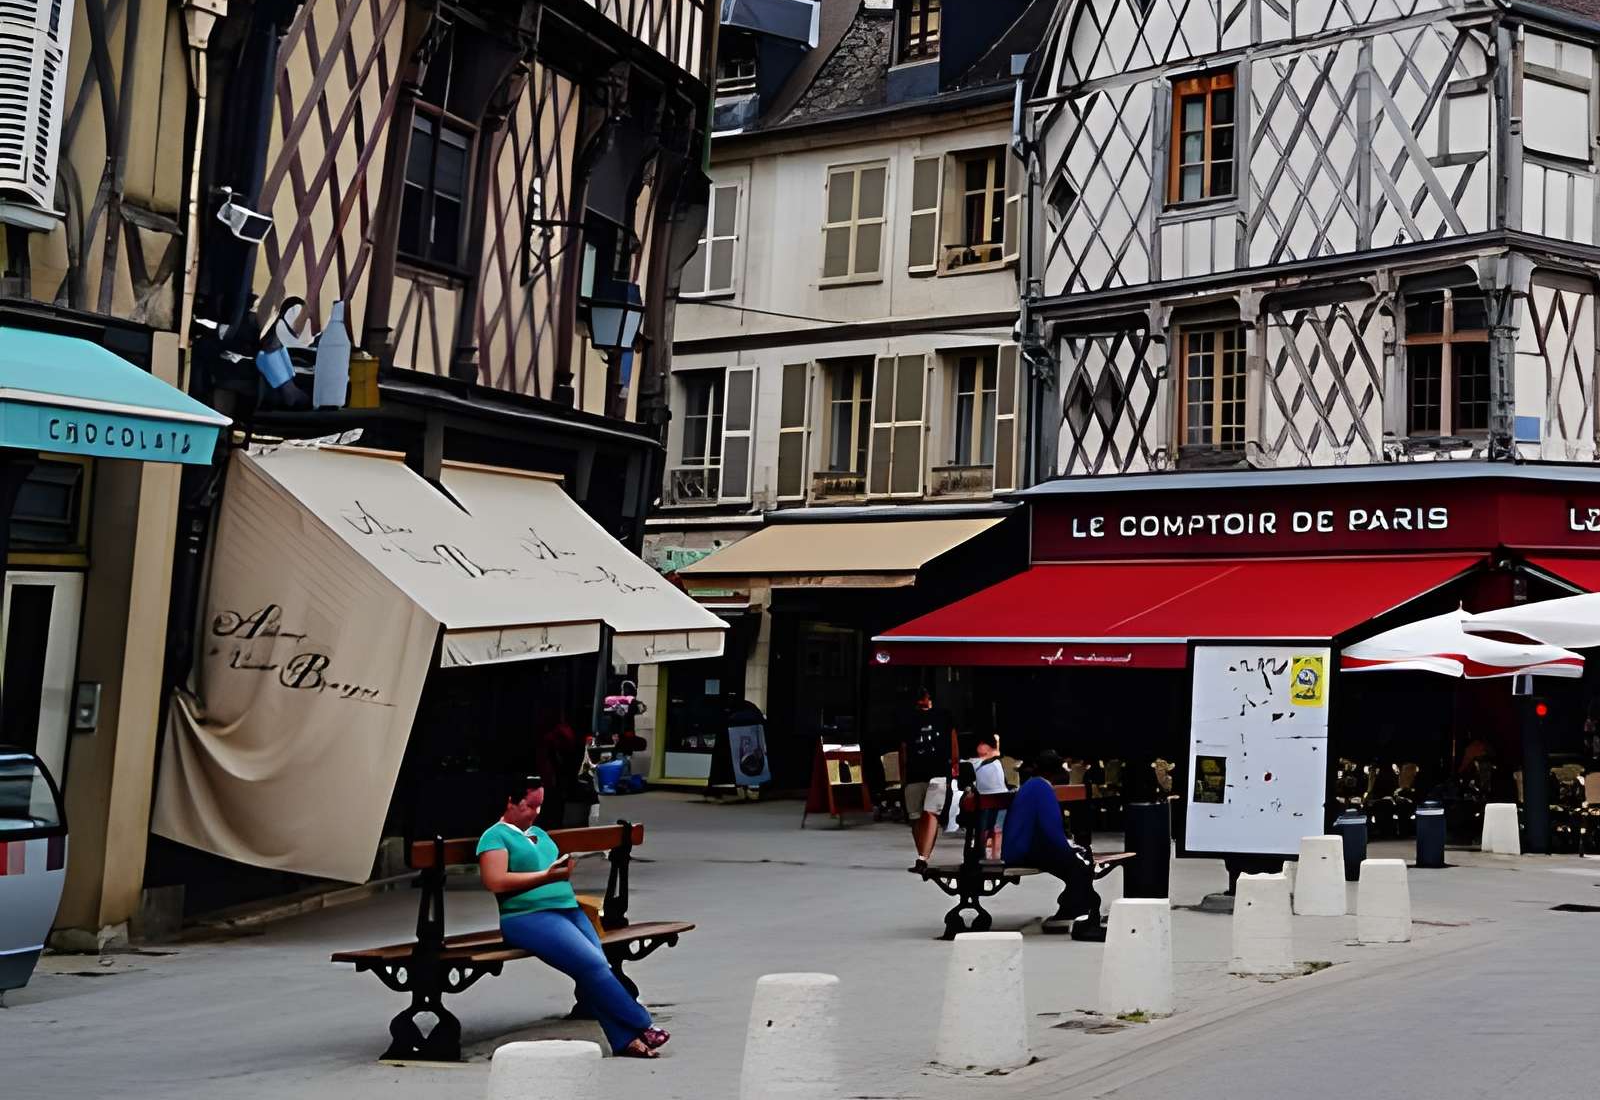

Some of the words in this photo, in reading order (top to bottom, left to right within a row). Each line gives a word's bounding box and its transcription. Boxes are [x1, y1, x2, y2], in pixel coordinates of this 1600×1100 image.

[1072, 516, 1105, 538] LE
[1120, 512, 1277, 537] COMPTOIR
[1292, 510, 1334, 533] DE
[1348, 507, 1449, 531] PARIS
